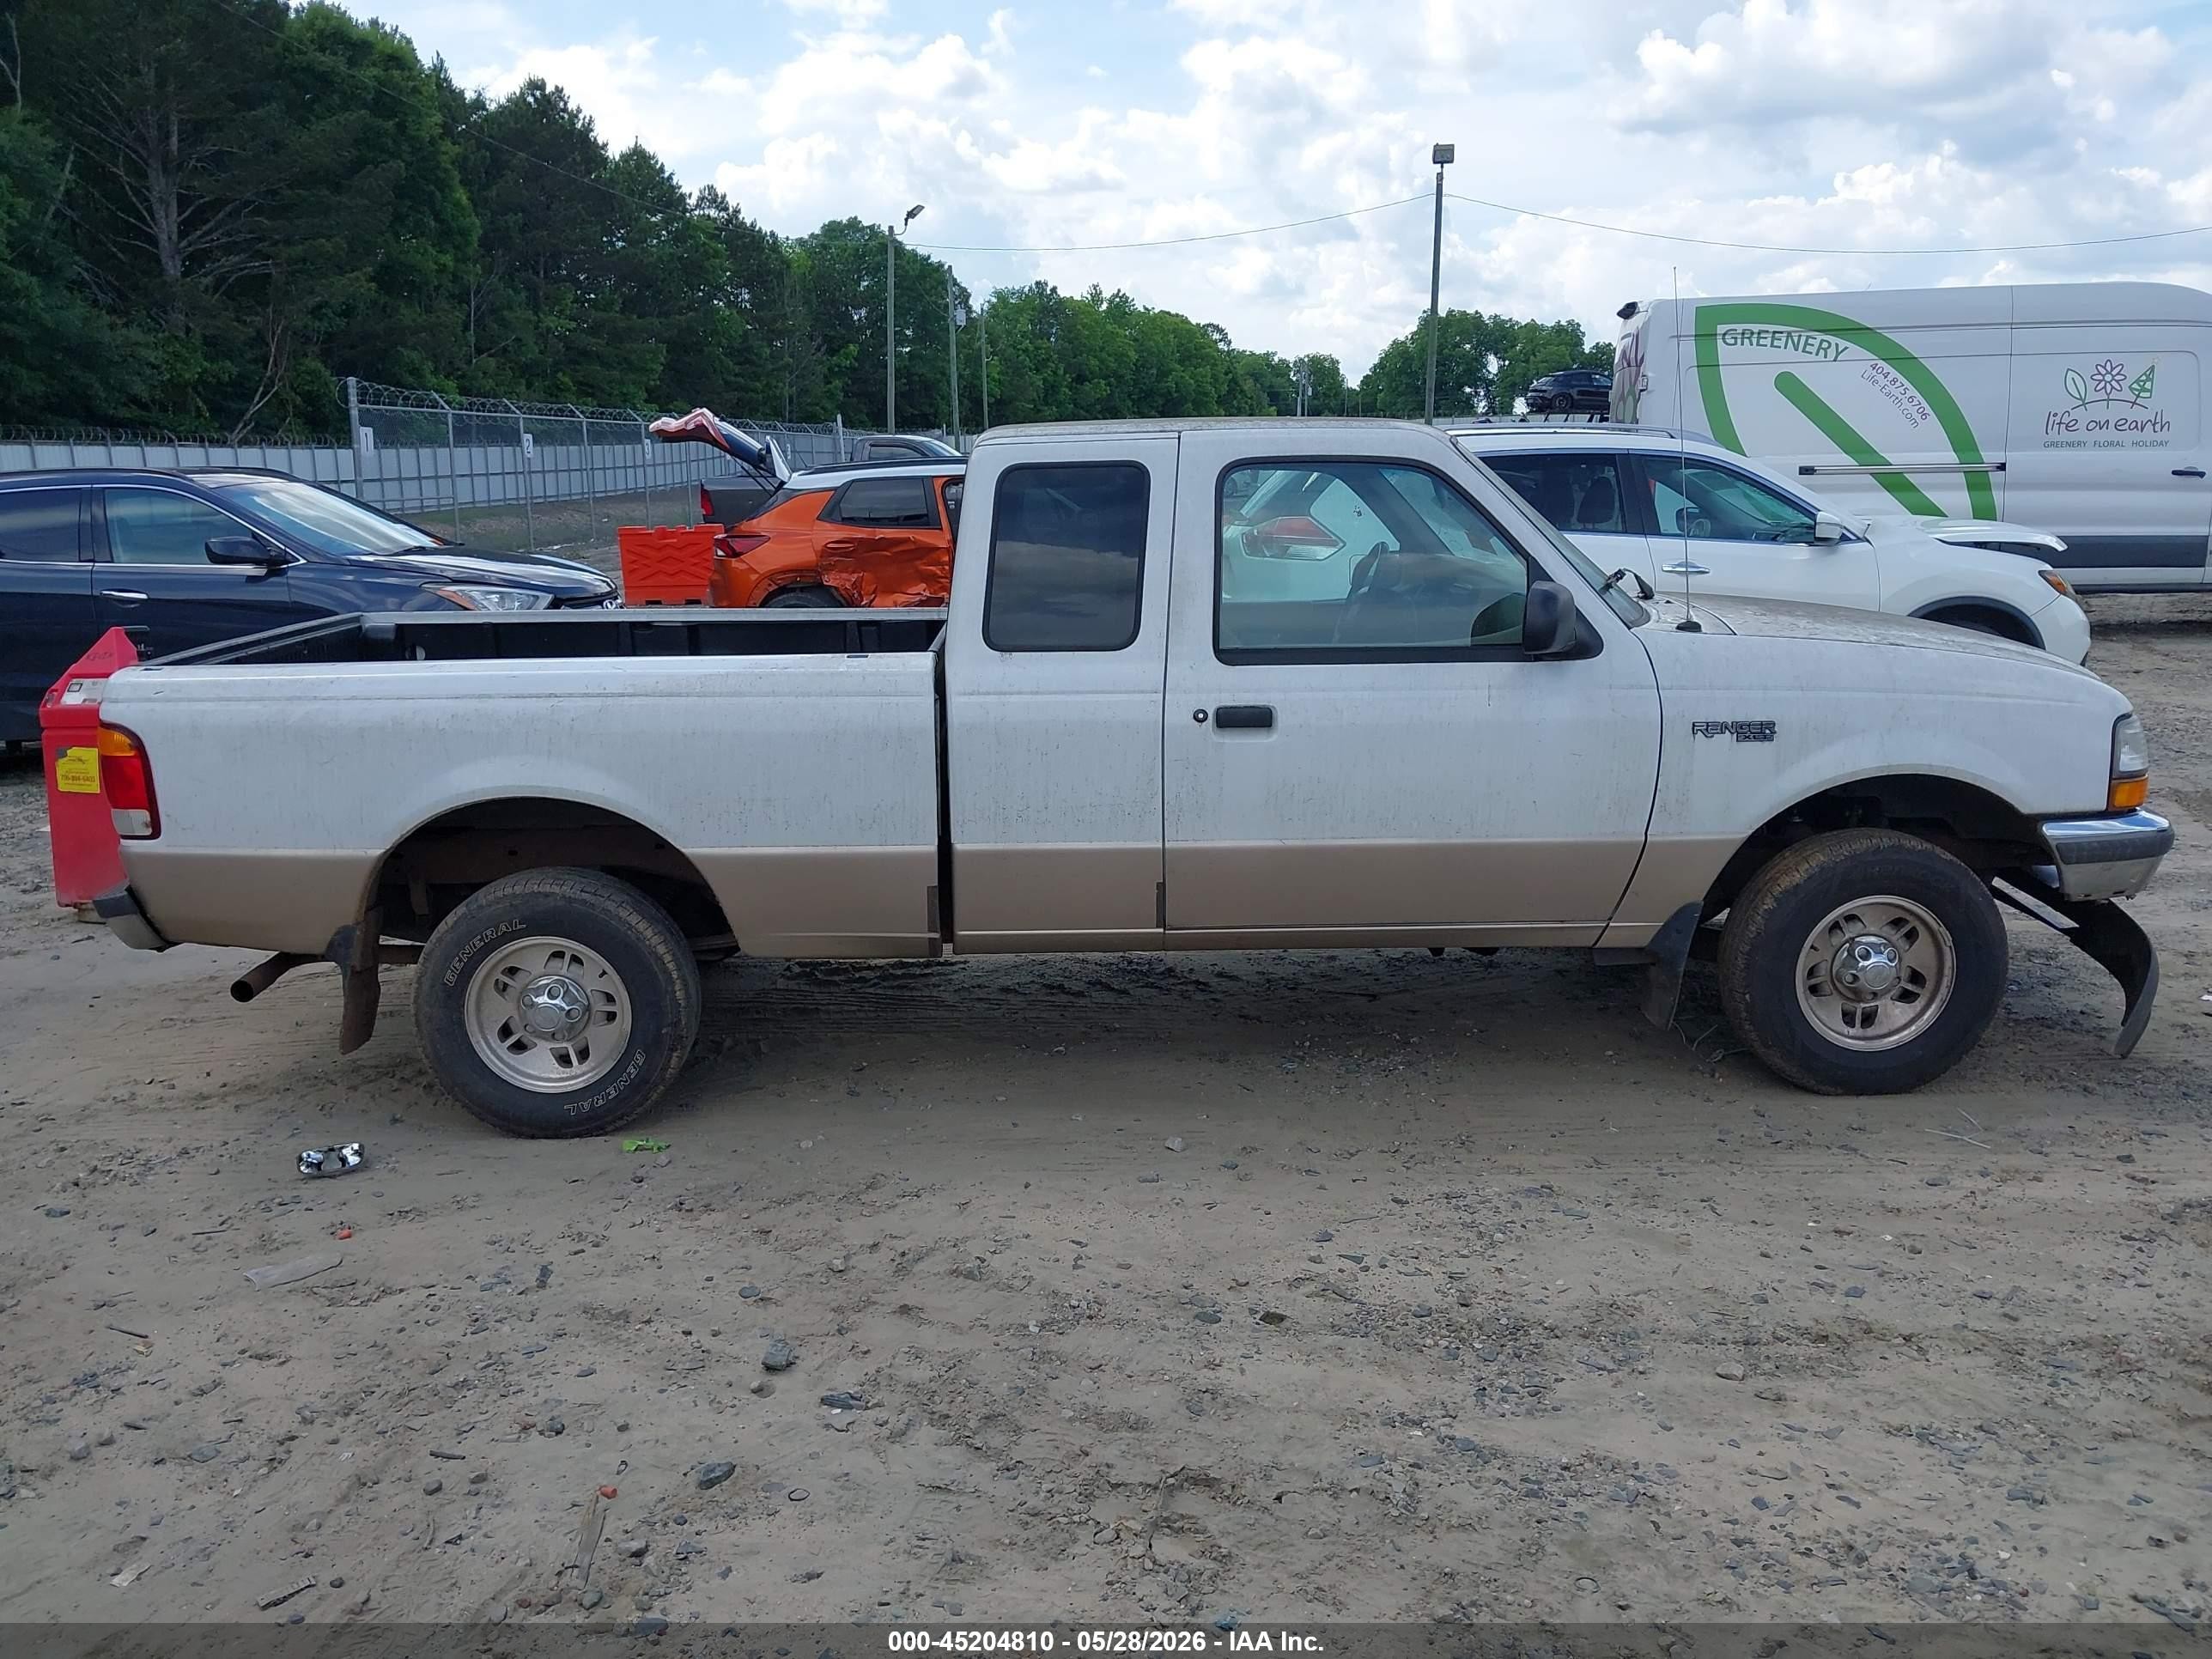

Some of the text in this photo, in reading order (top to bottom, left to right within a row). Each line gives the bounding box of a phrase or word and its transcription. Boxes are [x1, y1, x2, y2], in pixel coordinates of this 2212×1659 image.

[1722, 328, 1849, 362] GREENERY
[1861, 369, 1919, 428] Life-Earth.com
[1870, 363, 1930, 420] 404.875.6706
[2045, 410, 2171, 435] life on earth
[525, 438, 531, 454] 2
[2043, 440, 2087, 448] GREENERY
[1692, 720, 1777, 738] RANGER
[444, 919, 526, 987] GENERAL
[563, 1048, 646, 1115] GENERAL
